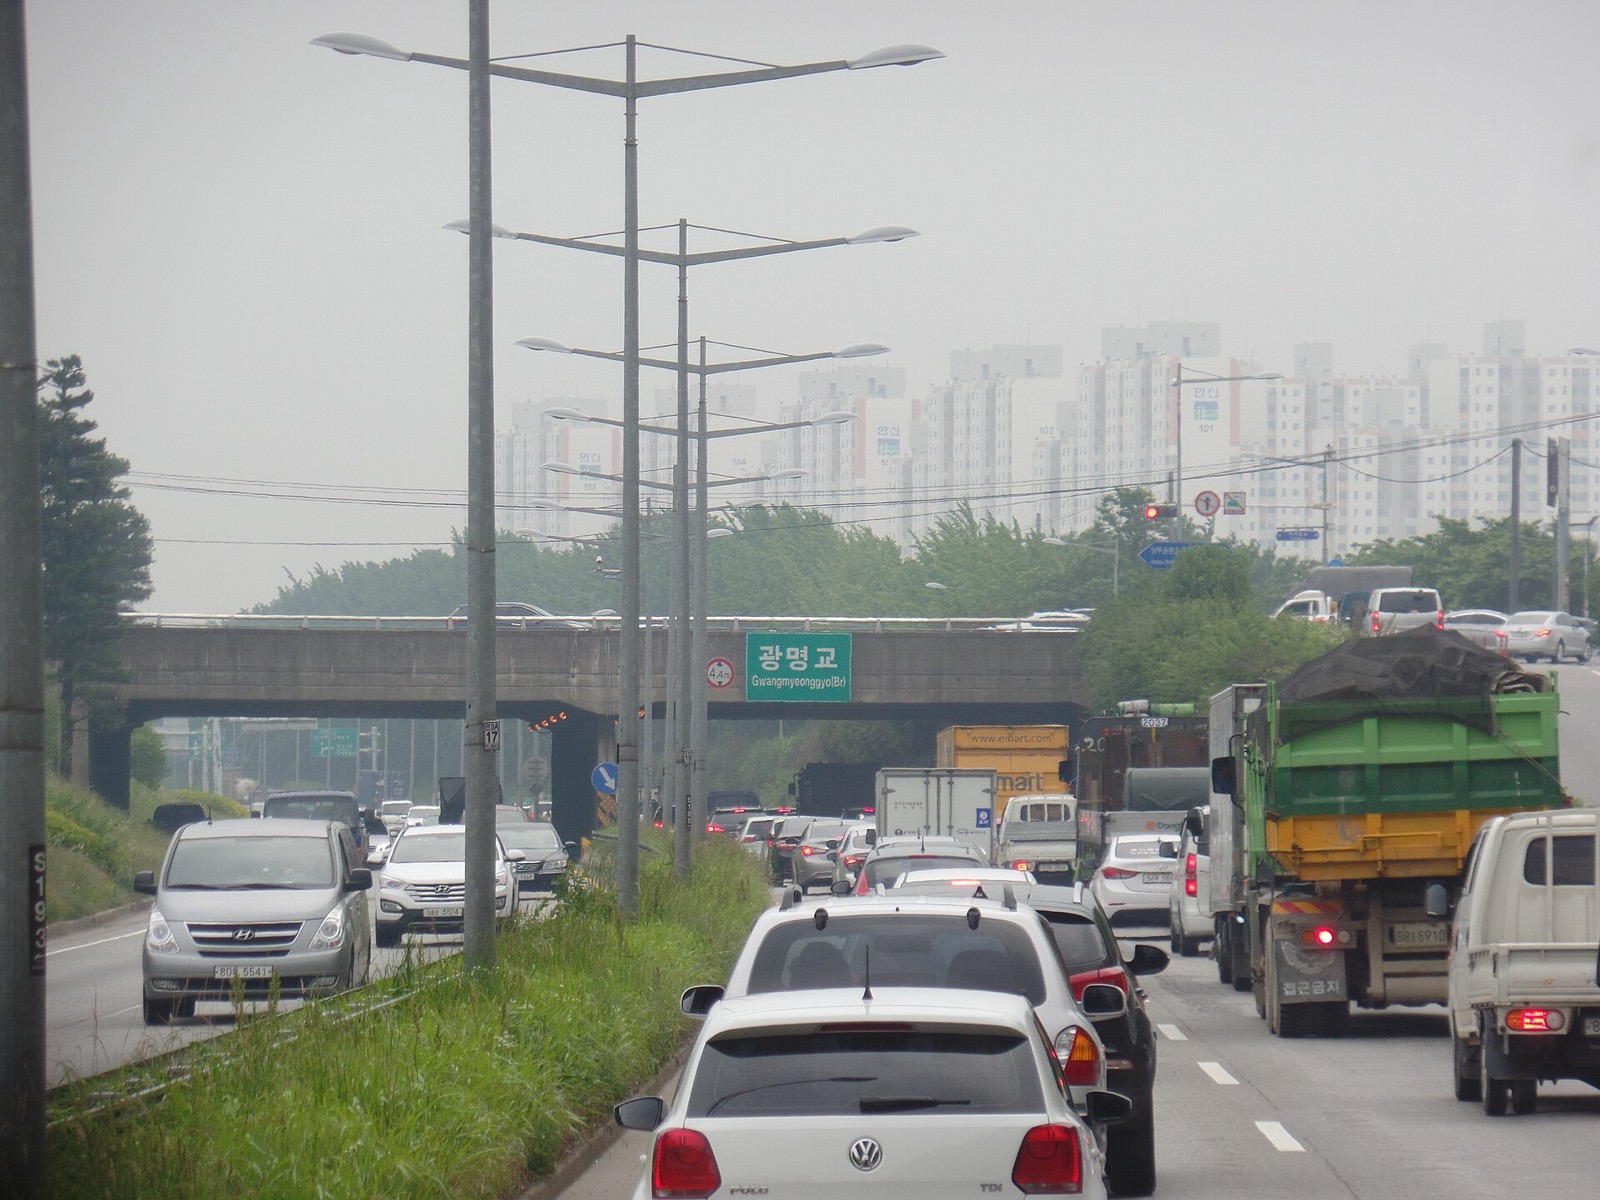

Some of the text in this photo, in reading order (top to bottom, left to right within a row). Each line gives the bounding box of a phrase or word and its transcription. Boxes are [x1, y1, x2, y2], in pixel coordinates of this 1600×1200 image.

[1039, 425, 1055, 435] 102
[1199, 424, 1215, 433] 101
[758, 645, 838, 671] 광명교
[708, 667, 730, 680] 4.4m
[752, 674, 847, 690] Gwangmyeonggyo(Br)
[1143, 718, 1167, 727] 2037
[486, 731, 498, 743] 17
[970, 732, 1052, 744] www.emart.com
[1283, 979, 1340, 997] 접근금지
[730, 1186, 769, 1195] POLO
